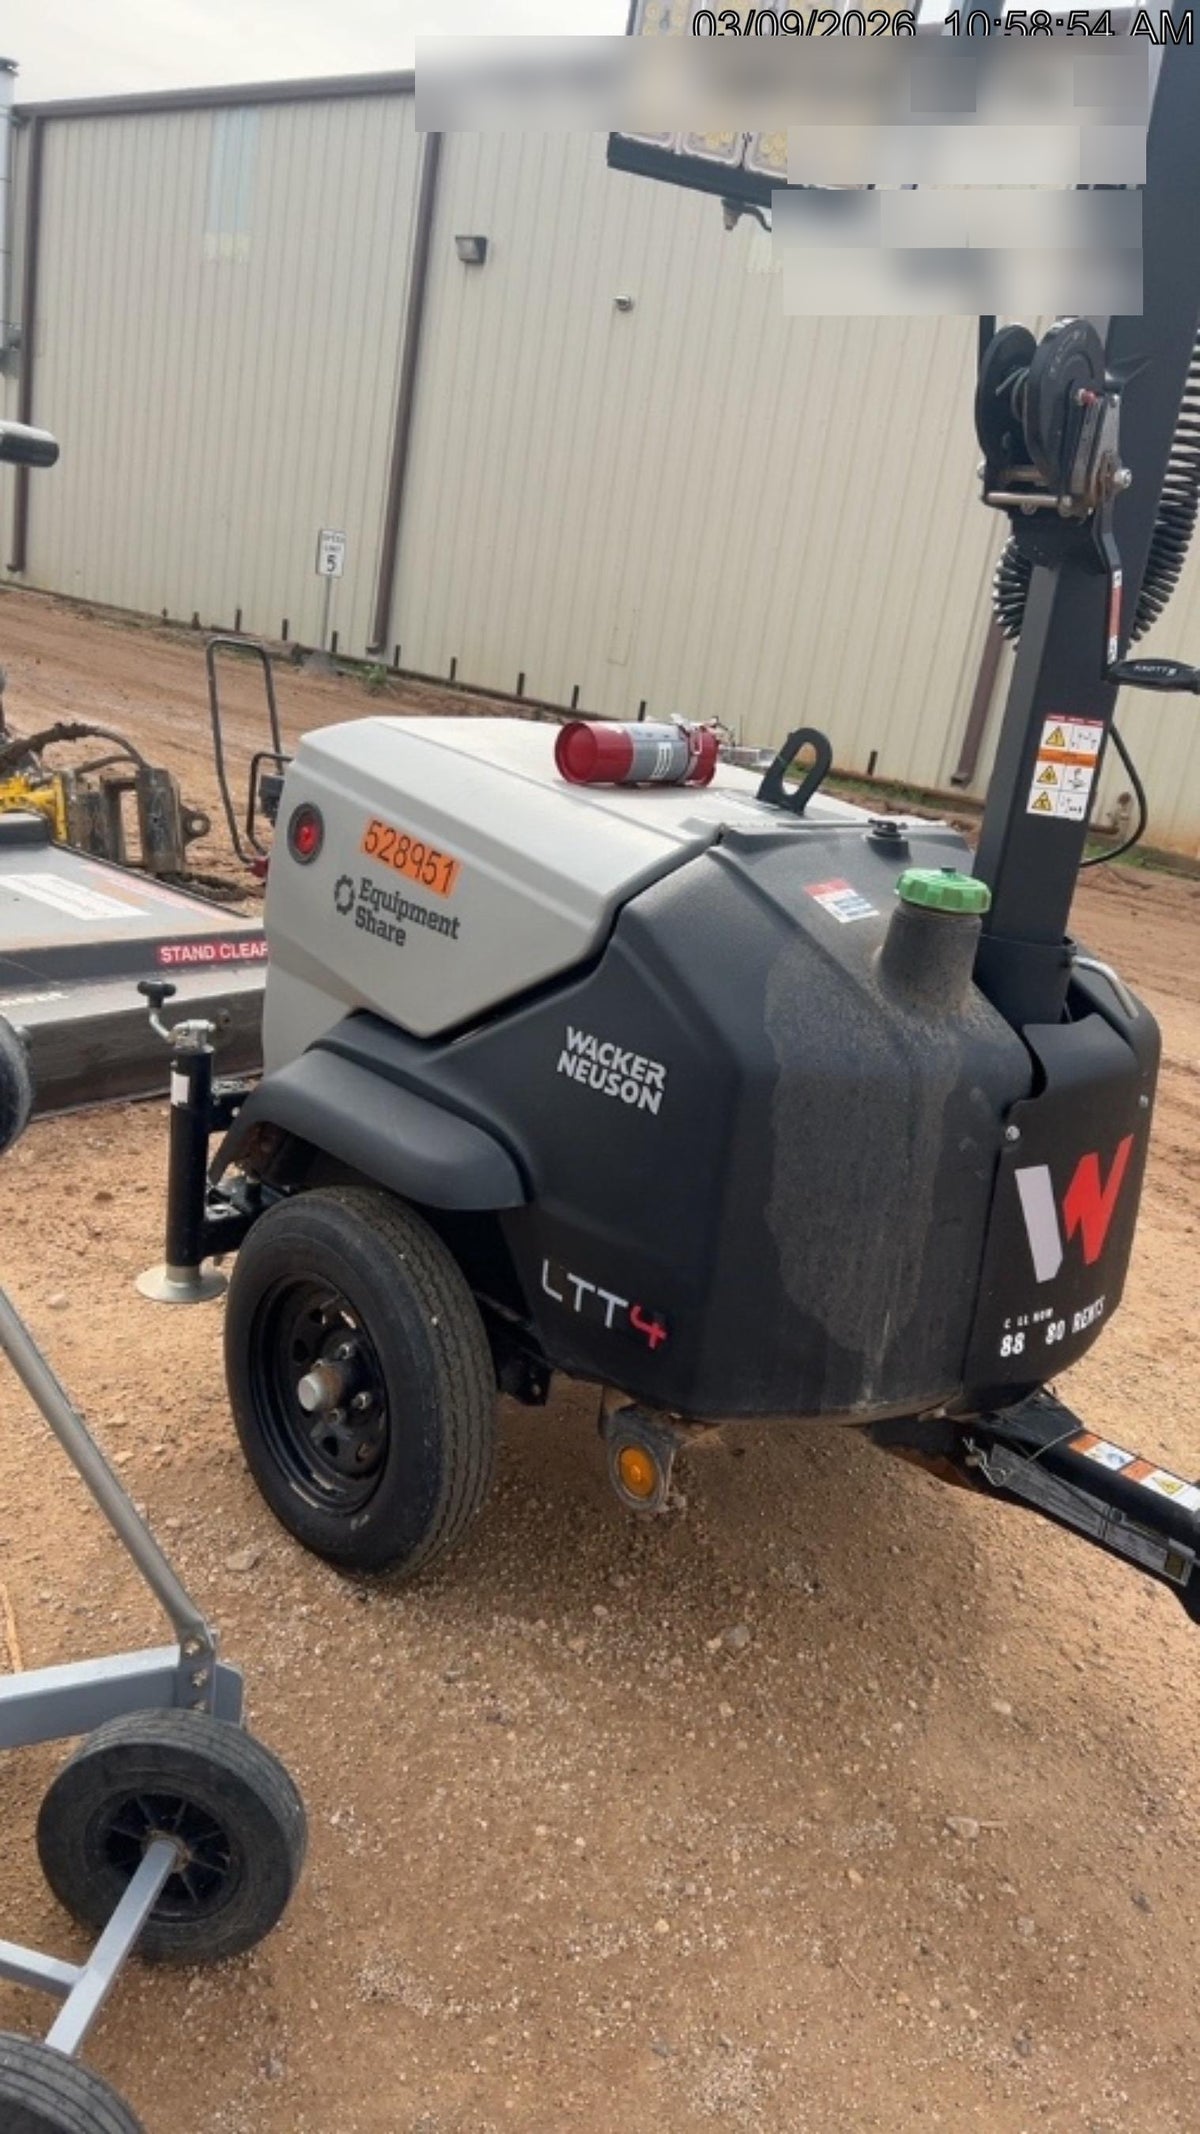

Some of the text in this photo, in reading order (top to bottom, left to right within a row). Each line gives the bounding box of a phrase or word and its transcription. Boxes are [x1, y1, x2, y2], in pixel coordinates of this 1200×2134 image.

[327, 554, 337, 572] 5
[364, 820, 455, 894] 528951
[354, 904, 407, 947] Share
[358, 876, 461, 940] Equipment
[160, 945, 215, 963] STAND
[556, 1049, 663, 1115] NEUSON
[566, 1025, 667, 1092] WACKER
[542, 1258, 667, 1350] LTT4
[1071, 1294, 1106, 1334] RENTS
